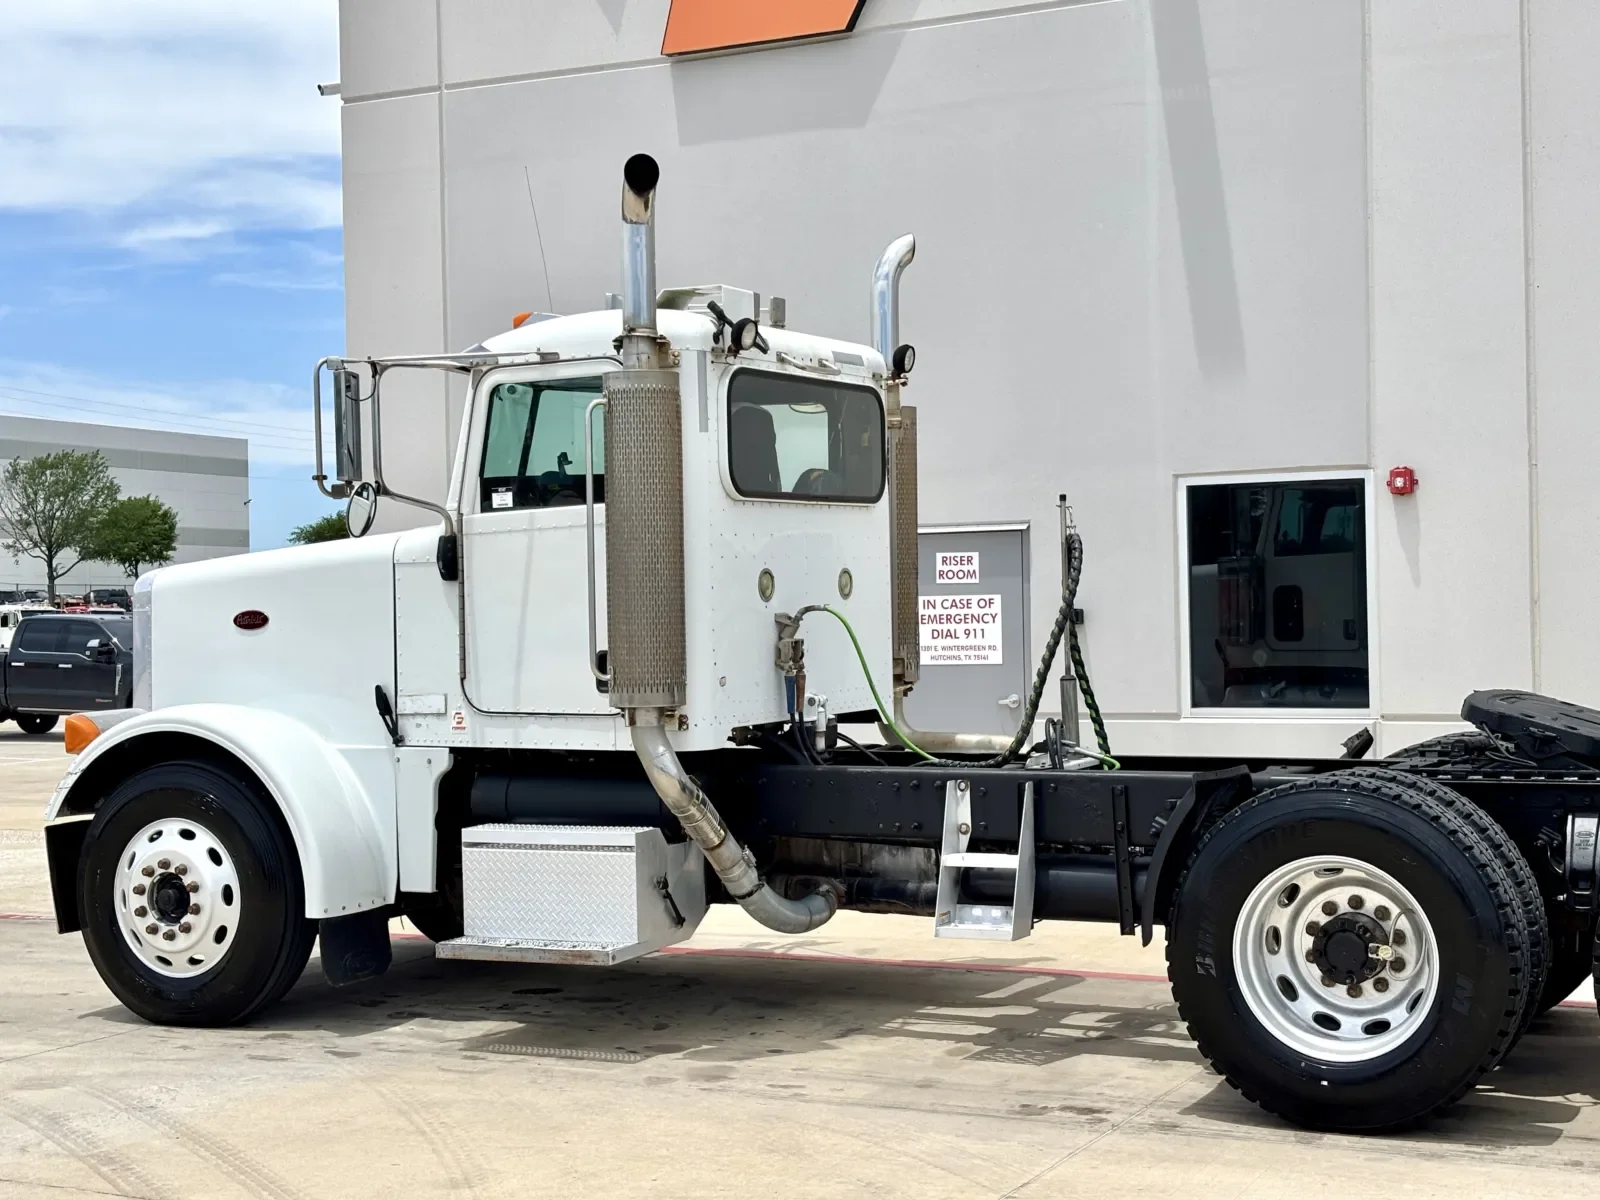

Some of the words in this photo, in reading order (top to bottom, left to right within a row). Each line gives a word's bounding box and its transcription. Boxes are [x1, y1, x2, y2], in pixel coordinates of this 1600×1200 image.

[941, 555, 974, 566] RISER
[938, 569, 977, 580] ROOM
[922, 599, 937, 610] IN
[941, 598, 973, 610] CASE
[977, 598, 995, 609] OF
[920, 612, 998, 625] EMERGENCY
[931, 628, 960, 640] DIAL
[964, 628, 985, 639] 911
